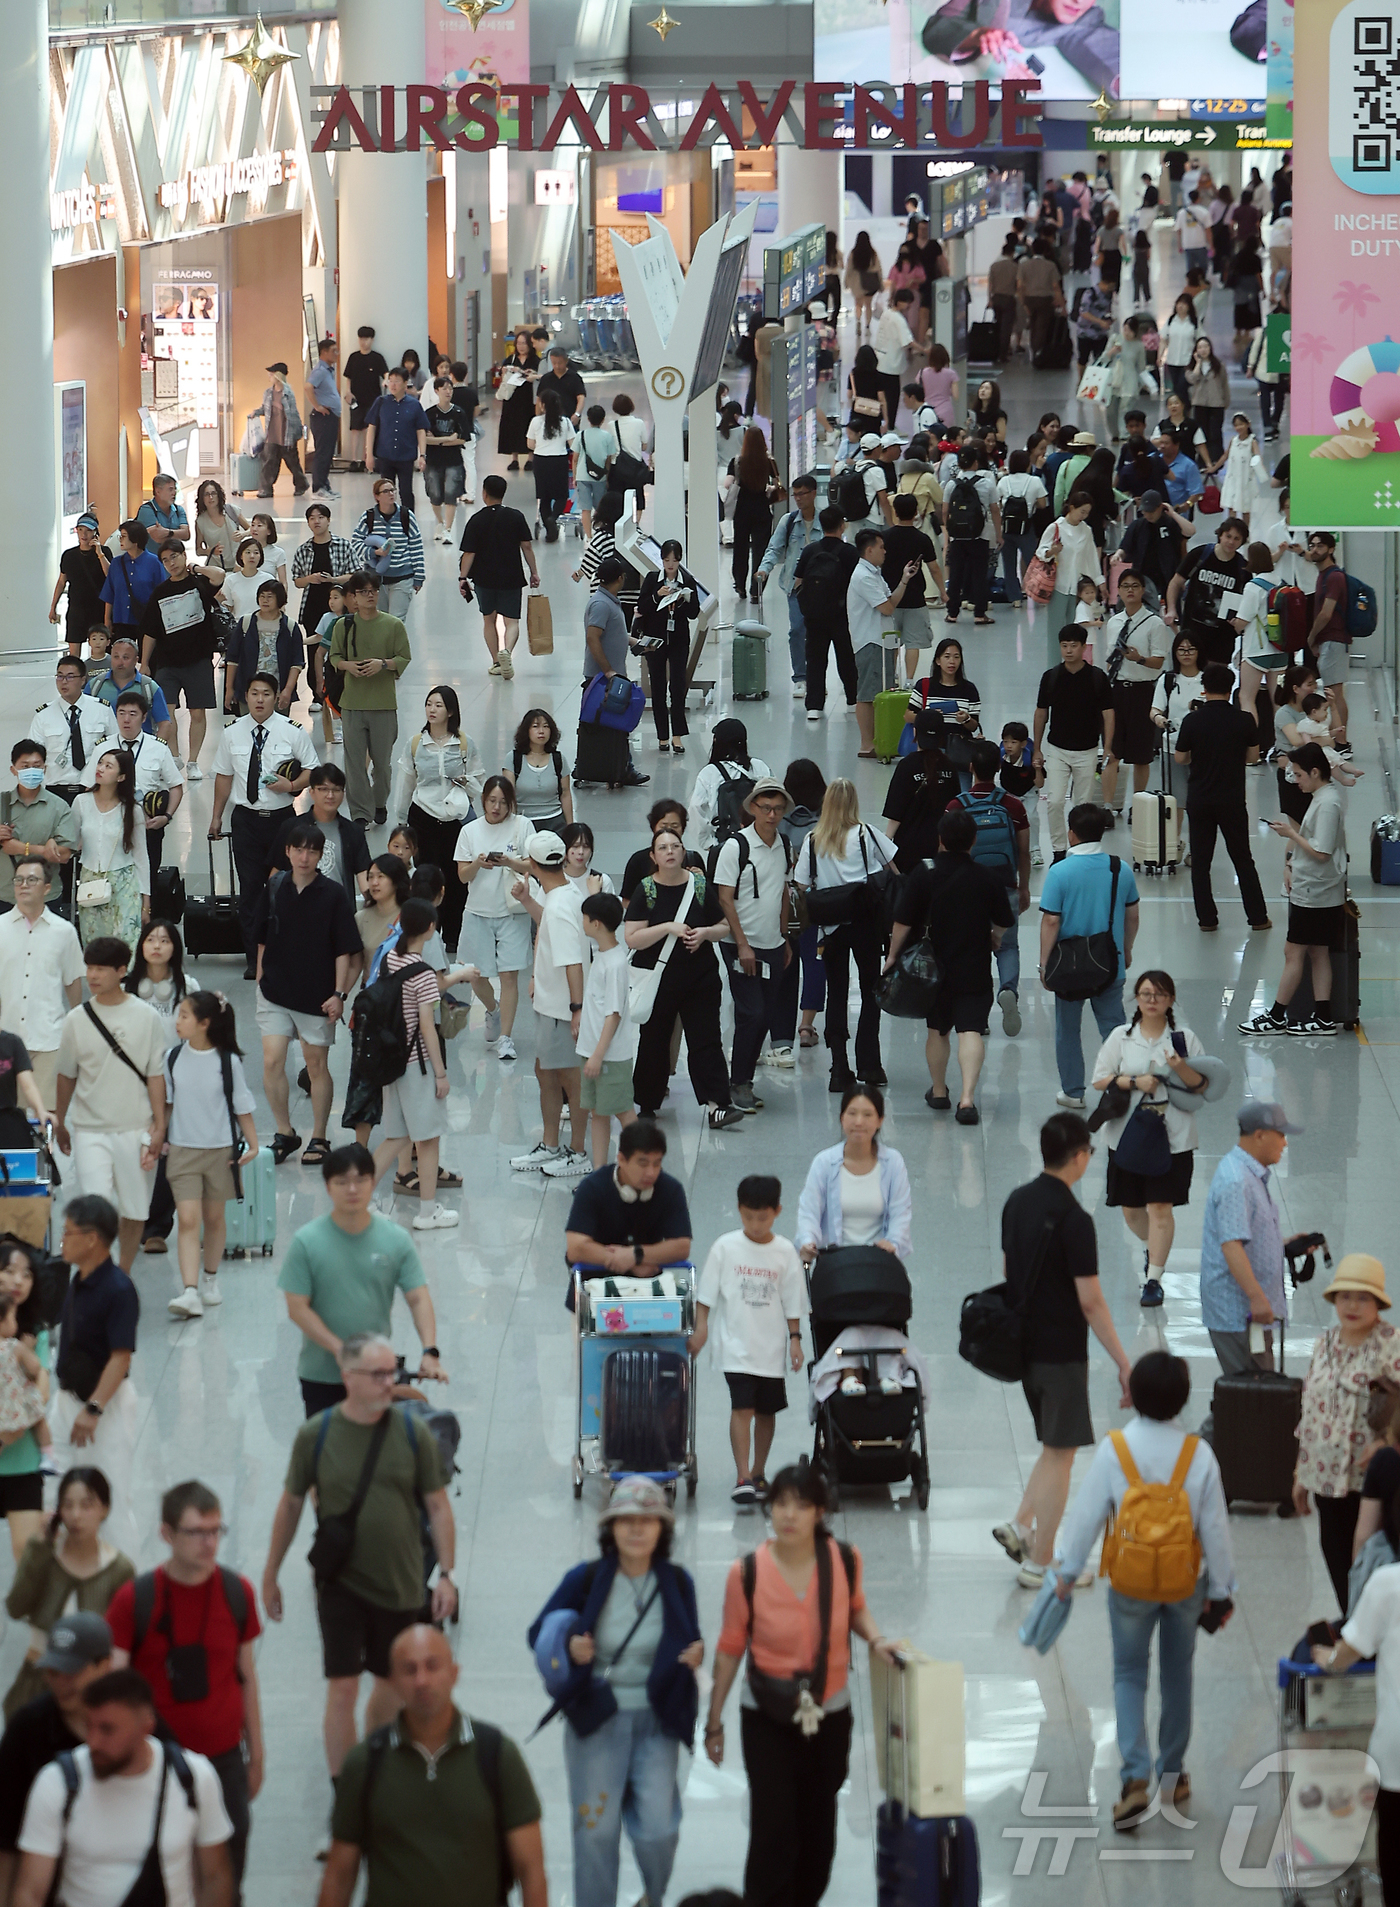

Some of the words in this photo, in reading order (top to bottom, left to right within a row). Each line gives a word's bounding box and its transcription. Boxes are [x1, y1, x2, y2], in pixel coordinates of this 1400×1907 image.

[311, 83, 658, 153] AIRSTAR
[679, 79, 1044, 151] AVENUE
[1091, 125, 1143, 143] Transfer
[1144, 126, 1193, 146] Lounge
[50, 185, 96, 231] WATCHES
[1334, 213, 1400, 231] INCHE
[158, 270, 213, 279] FERRAGAMO
[1279, 351, 1291, 363] A
[1198, 569, 1237, 590] ORCHID
